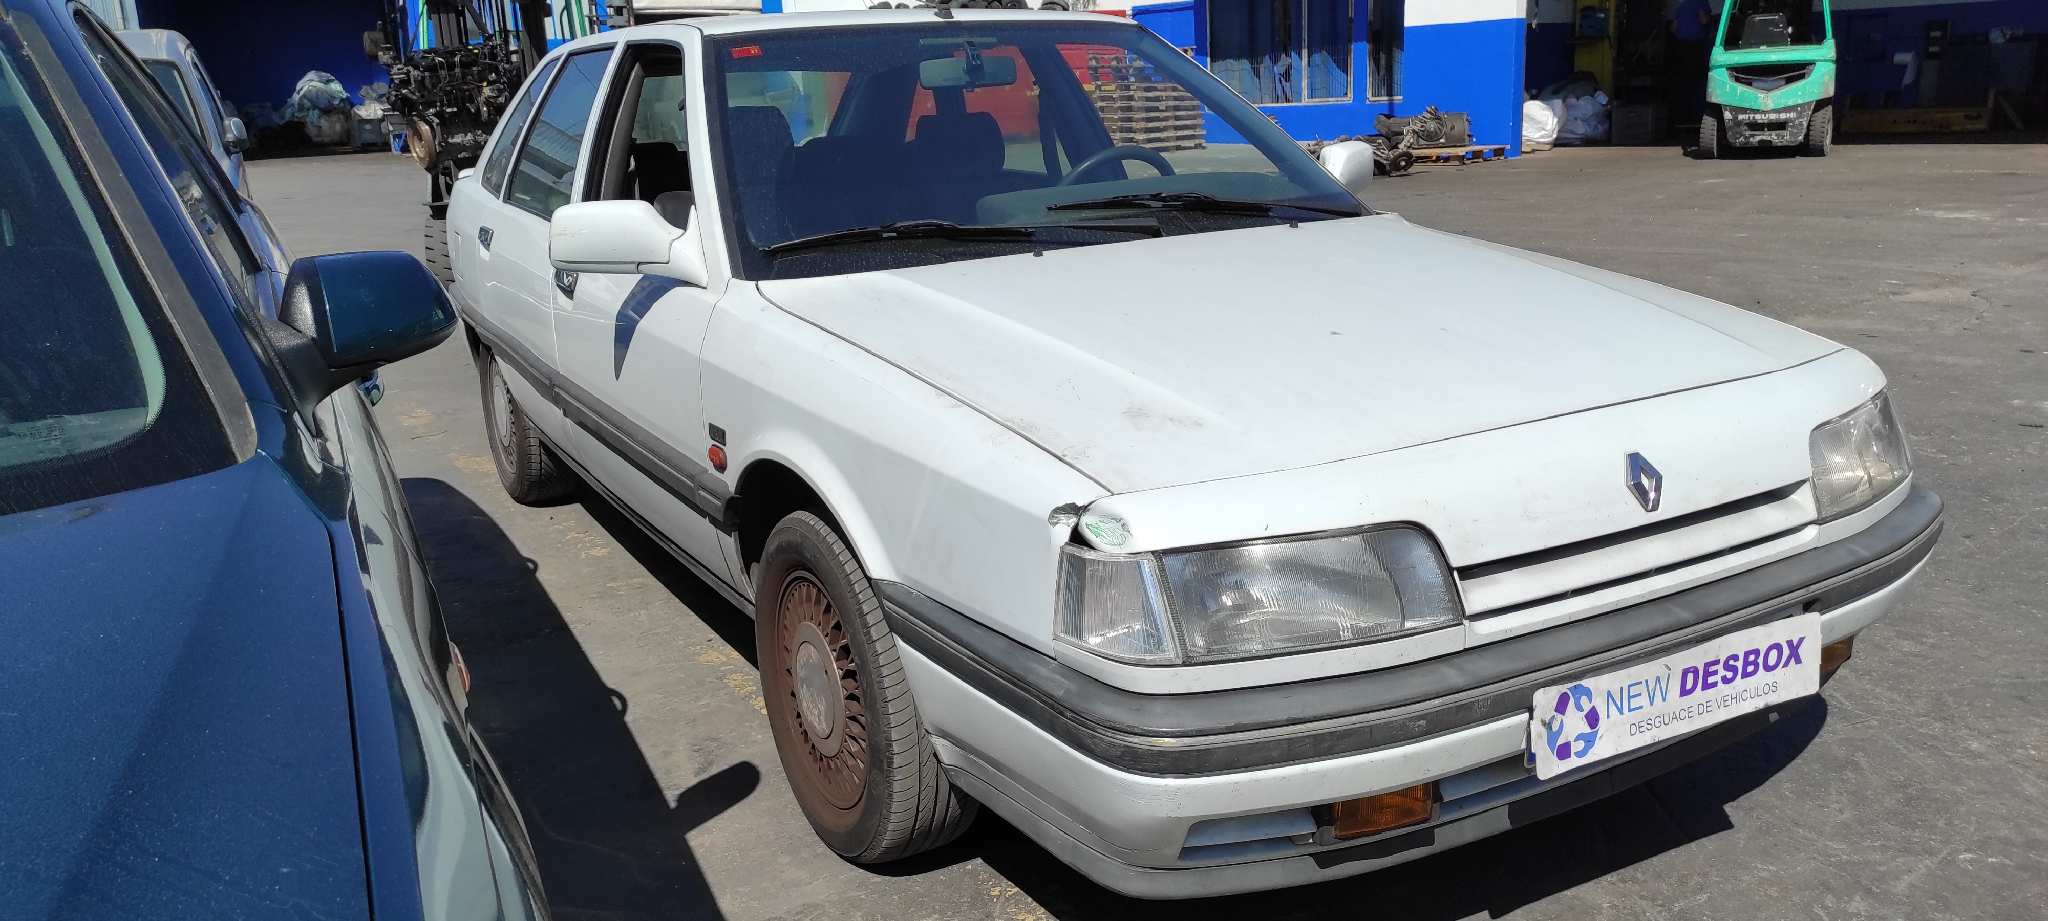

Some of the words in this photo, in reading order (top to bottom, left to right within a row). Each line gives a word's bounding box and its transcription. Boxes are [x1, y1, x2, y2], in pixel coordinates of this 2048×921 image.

[1738, 112, 1797, 120] MITSUBISHI
[1606, 673, 1671, 719] NEW
[1679, 636, 1806, 698] DESBOX
[1629, 705, 1695, 736] DESGUACE
[1697, 699, 1713, 716] DE
[1715, 681, 1778, 709] VEHICULOS
